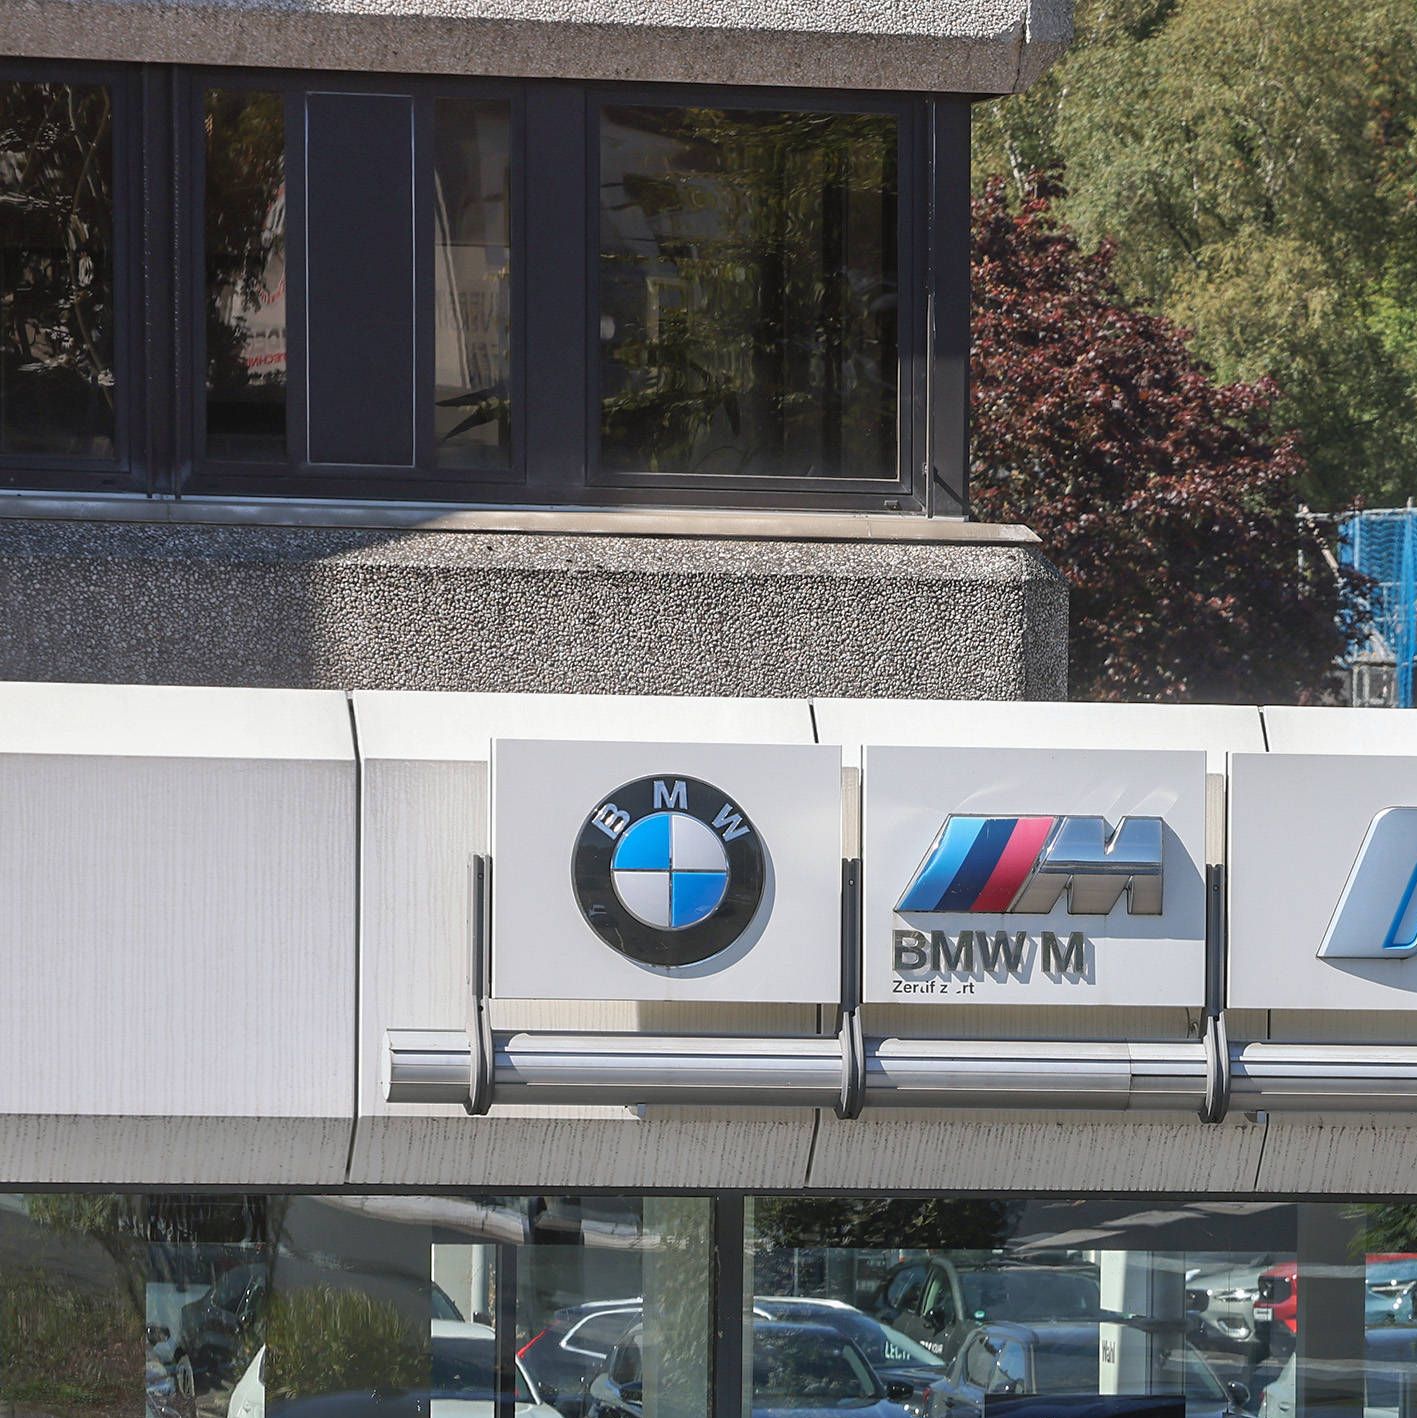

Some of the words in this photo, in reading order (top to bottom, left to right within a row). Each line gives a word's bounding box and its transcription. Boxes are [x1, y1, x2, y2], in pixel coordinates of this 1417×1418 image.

[592, 779, 750, 840] BMW
[892, 929, 1024, 974] BMW
[1040, 930, 1086, 974] M
